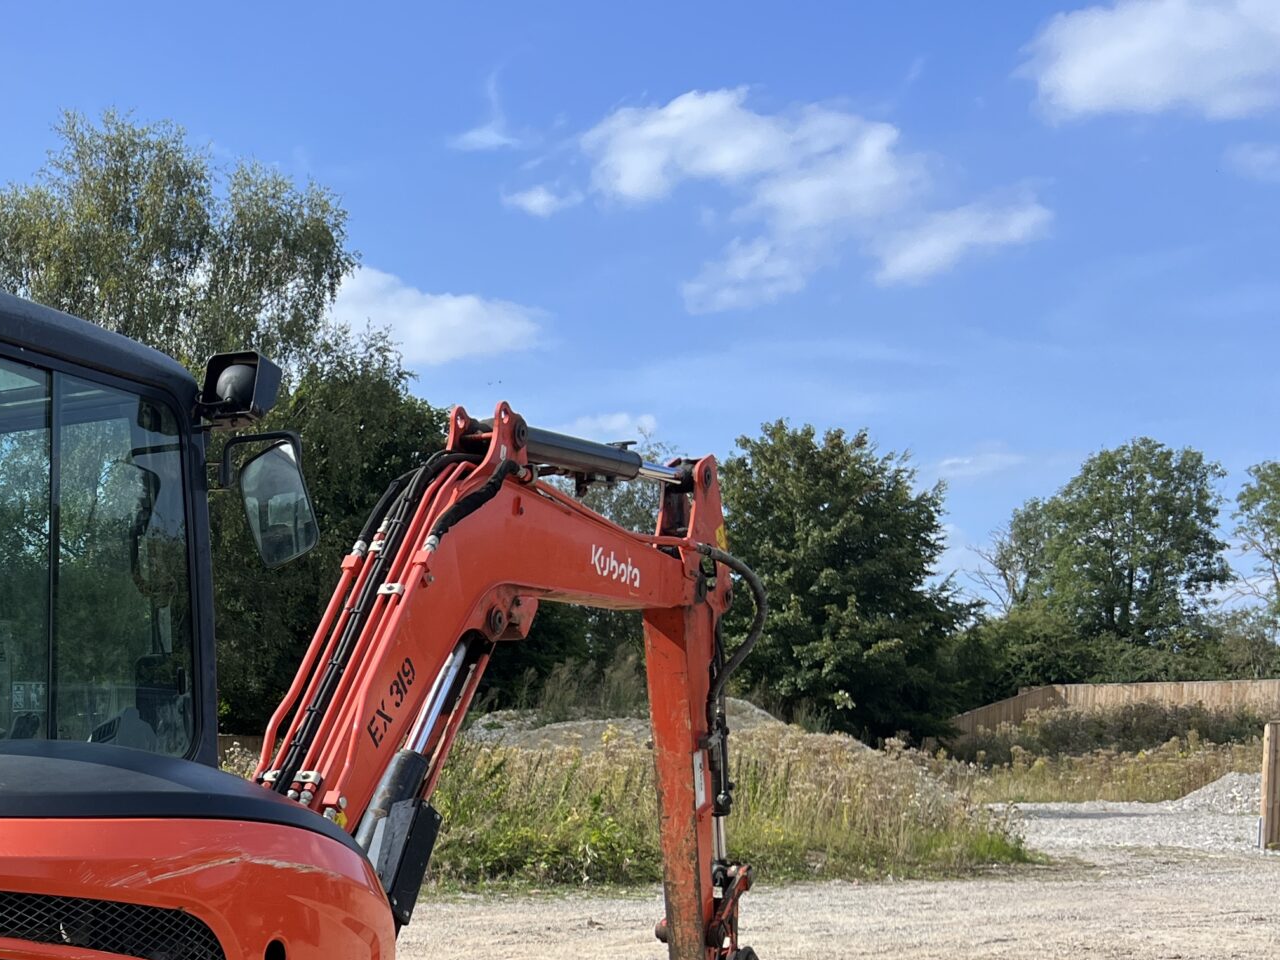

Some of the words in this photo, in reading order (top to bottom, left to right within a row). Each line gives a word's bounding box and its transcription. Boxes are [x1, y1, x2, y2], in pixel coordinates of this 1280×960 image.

[591, 544, 640, 588] Kubota
[367, 699, 392, 748] EX
[390, 657, 415, 707] 319
